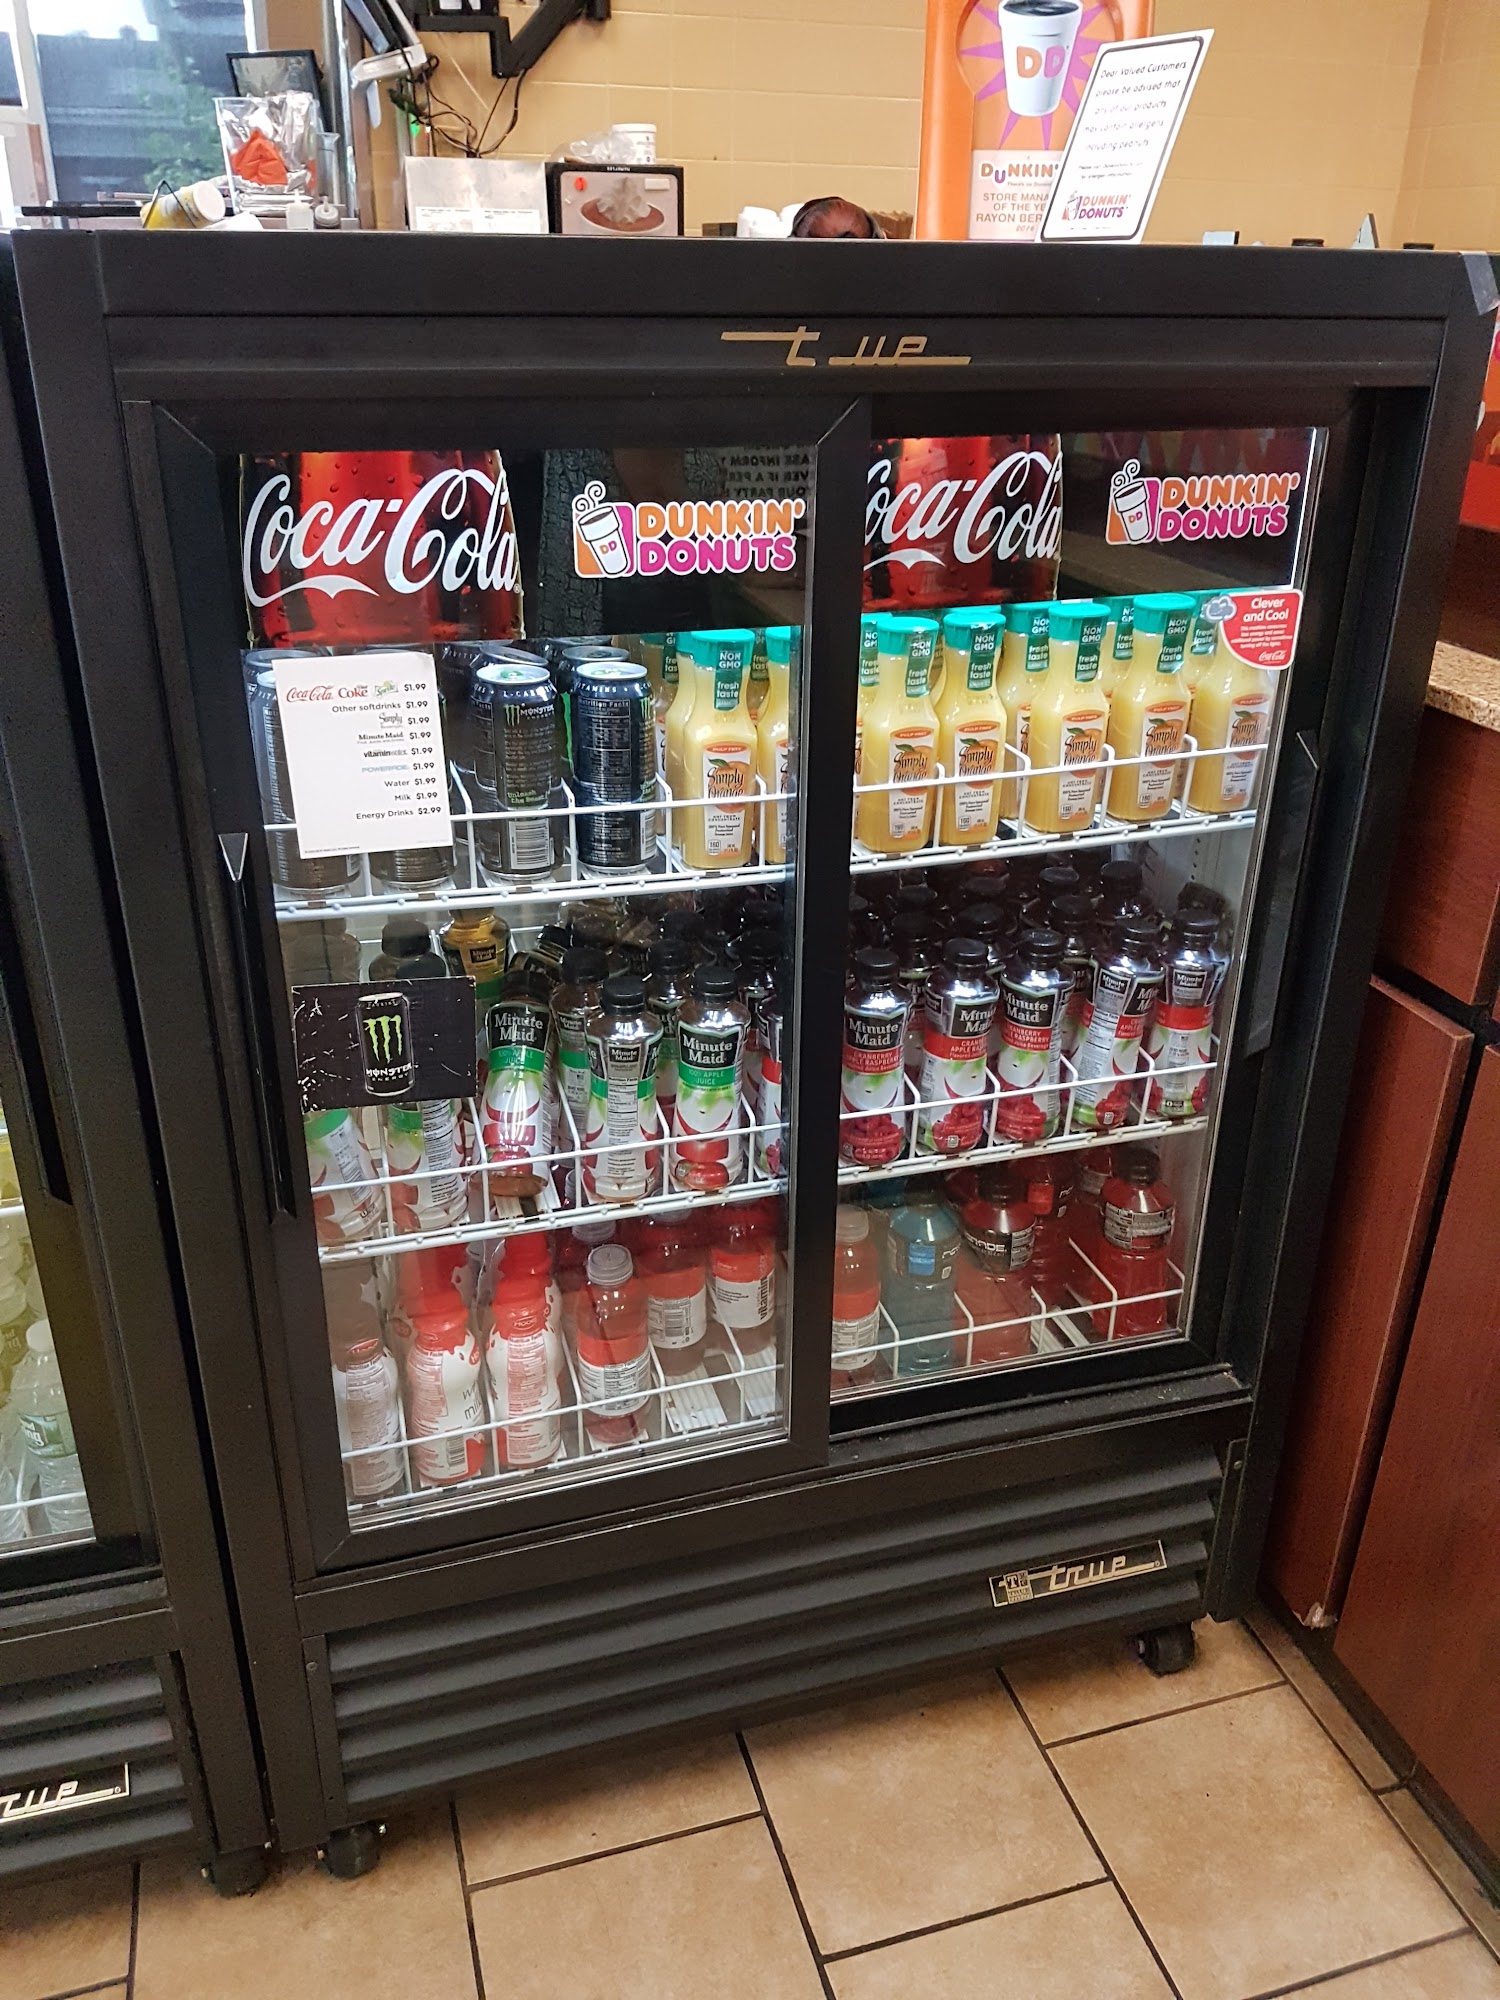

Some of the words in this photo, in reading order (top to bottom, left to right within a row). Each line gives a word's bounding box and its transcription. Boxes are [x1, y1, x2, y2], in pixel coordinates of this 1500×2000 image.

[1016, 46, 1066, 79] DD
[1147, 62, 1187, 73] Customers
[981, 163, 1059, 184] DUNKIN'
[983, 192, 1018, 201] STORE
[1083, 194, 1131, 206] DUNKIN'
[993, 202, 1007, 211] OF
[1011, 202, 1030, 211] THE
[976, 213, 1015, 223] RAYON
[1079, 207, 1126, 219] DONUTS
[1162, 472, 1300, 505] DUNKIN'
[637, 499, 805, 538] DUNKIN'
[1158, 503, 1289, 541] DONUTS
[242, 467, 517, 607] Coca-Cola
[636, 535, 797, 574] DONUTS
[1251, 597, 1285, 609] Clever
[1243, 612, 1264, 622] and
[1265, 608, 1289, 621] Cool
[1168, 619, 1187, 628] NON
[1083, 627, 1102, 636] NON
[1167, 627, 1186, 635] GMO
[974, 634, 995, 643] NON
[1082, 635, 1101, 643] GMO
[974, 642, 995, 651] GMO
[1029, 645, 1049, 653] fresh
[1162, 645, 1182, 653] fresh
[719, 652, 741, 661] NON
[911, 648, 931, 657] GMO
[1028, 653, 1049, 661] taste
[1079, 655, 1098, 663] fresh
[719, 660, 741, 669] GMO
[971, 662, 992, 671] fresh
[1077, 663, 1097, 671] taste
[908, 668, 927, 677] fresh
[970, 671, 991, 679] taste
[717, 681, 739, 690] fresh
[907, 677, 927, 686] taste
[286, 685, 334, 703] Coca-Cola
[338, 686, 369, 699] Coke
[404, 683, 426, 692] $1.99
[716, 689, 738, 698] taste
[332, 705, 356, 713] Other
[359, 702, 401, 712] softdrinks
[406, 701, 428, 709] $1.99
[520, 703, 555, 716] MONSTER
[408, 717, 429, 725] $1.99
[1146, 726, 1178, 743] Simply
[1065, 734, 1097, 755] Simply
[411, 747, 433, 755] $1.99
[959, 745, 994, 766] Simply
[413, 762, 434, 770] $1.99
[894, 751, 928, 772] Simply
[415, 777, 436, 786] $1.99
[707, 767, 744, 788] Simply
[416, 792, 437, 800] $1.99
[356, 812, 385, 820] Energy
[388, 809, 413, 817] Drinks
[418, 806, 441, 815] $2.99
[1102, 974, 1125, 987] Minute
[1177, 973, 1202, 982] Minute
[1003, 988, 1049, 1012] Minute
[1007, 1003, 1040, 1023] Maid
[494, 1012, 544, 1030] Minute
[848, 1017, 899, 1035] Minute
[499, 1027, 535, 1042] Maid
[855, 1031, 891, 1046] Maid
[682, 1033, 733, 1053] Minute
[611, 1048, 638, 1057] Minute
[688, 1048, 724, 1064] Maid
[615, 1054, 634, 1062] Maid
[366, 1062, 413, 1077] MONSTER
[703, 1070, 724, 1078] APPLE
[998, 1554, 1156, 1591] true
